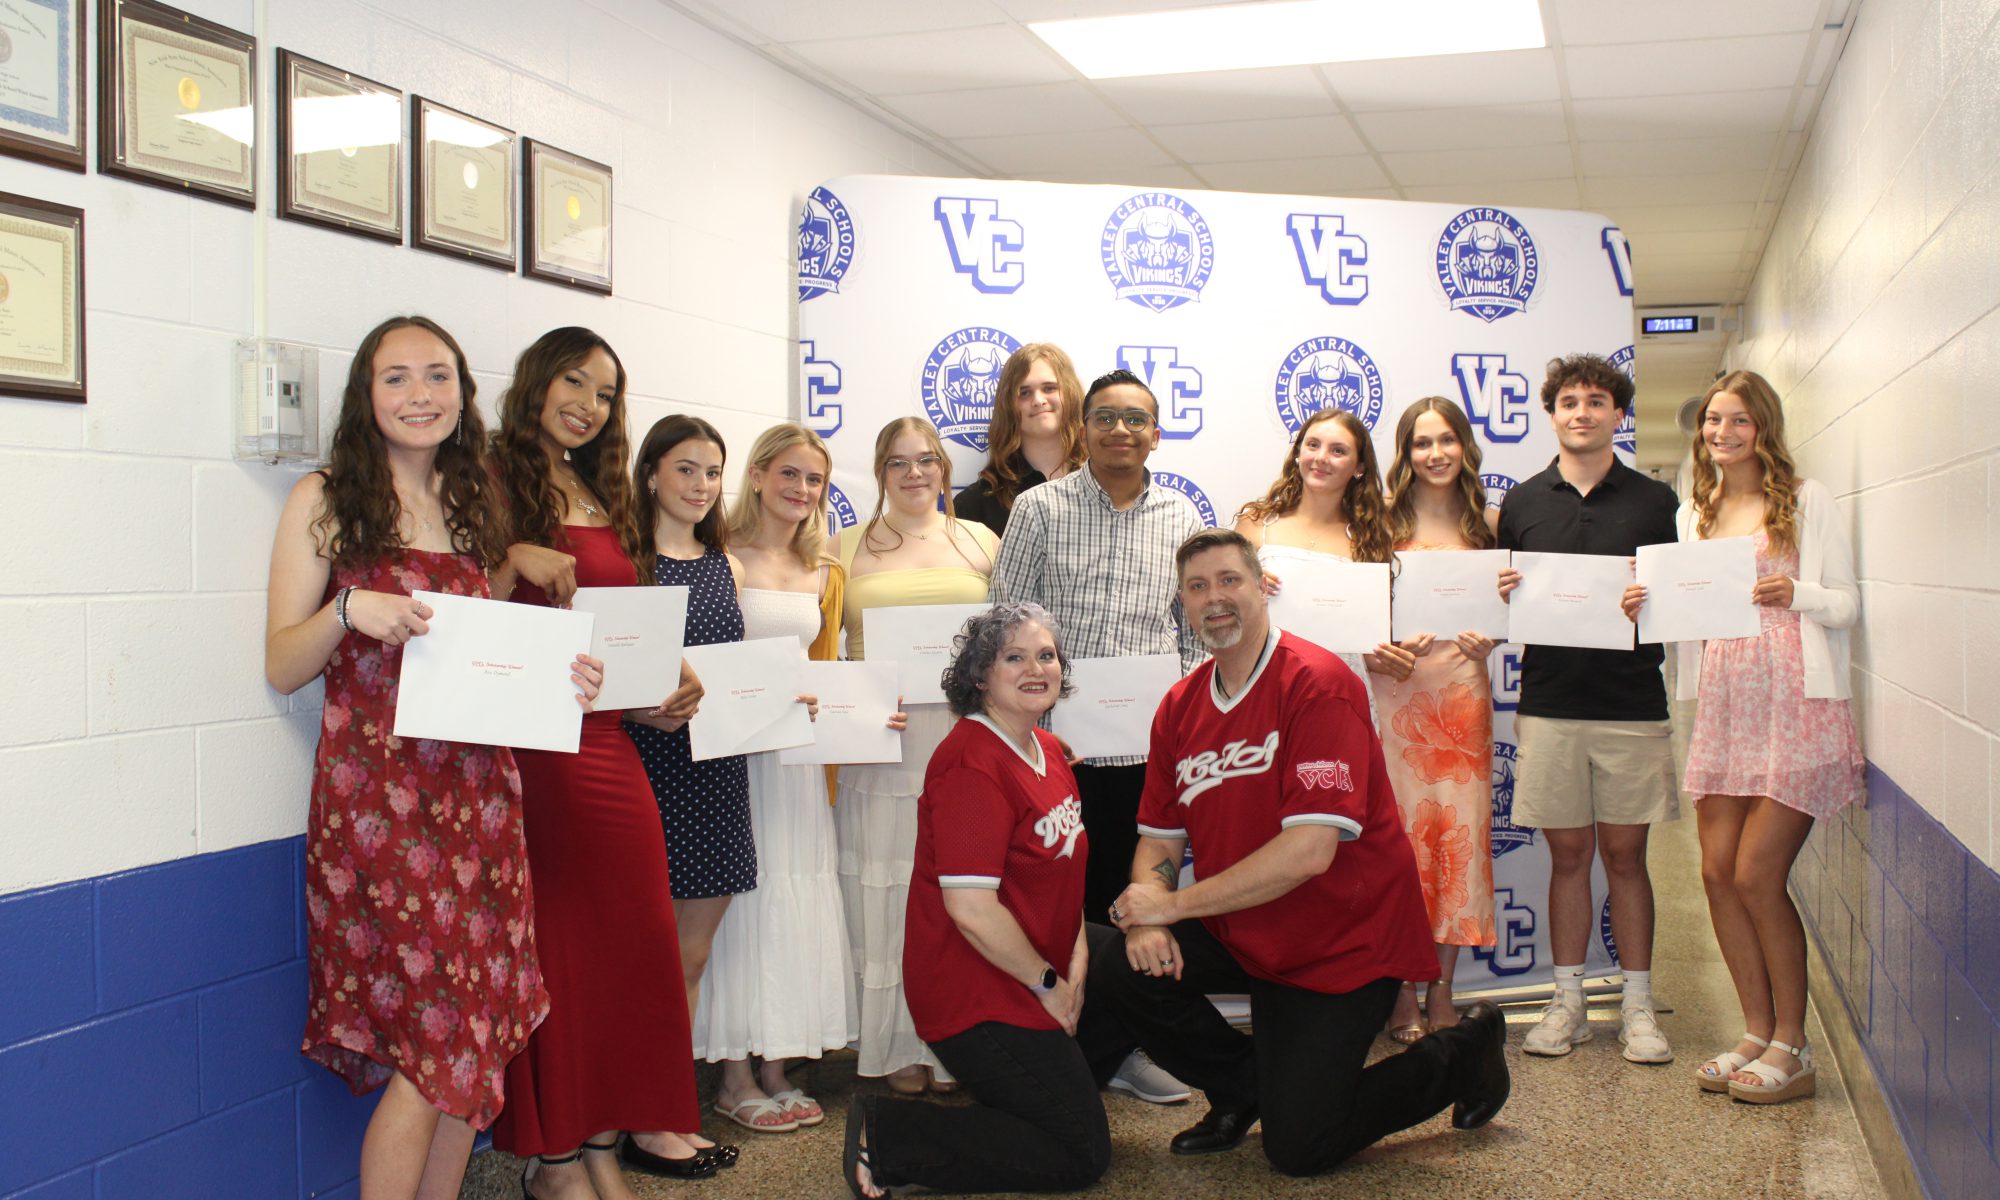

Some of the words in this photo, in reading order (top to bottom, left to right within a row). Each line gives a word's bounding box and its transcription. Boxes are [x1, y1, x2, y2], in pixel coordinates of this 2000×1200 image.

[826, 198, 853, 278] SCHOOLS
[934, 197, 1024, 294] VC
[1102, 219, 1123, 286] VALLEY
[1116, 193, 1185, 220] CENTRAL
[1188, 211, 1213, 288] SCHOOLS
[1131, 265, 1184, 285] VIKINGS
[1286, 213, 1368, 306] VC
[1437, 234, 1457, 297] VALLEY
[1449, 209, 1511, 234] CENTRAL
[1514, 226, 1537, 299] SCHOOLS
[1464, 277, 1511, 296] VIKINGS
[923, 357, 944, 424] VALLEY
[937, 328, 1009, 356] CENTRAL
[954, 403, 994, 422] VIKIN
[1277, 365, 1296, 428] VALLEY
[1290, 338, 1355, 364] CENTRAL
[1358, 355, 1382, 430] SCHOOLS
[1451, 353, 1529, 443] VC
